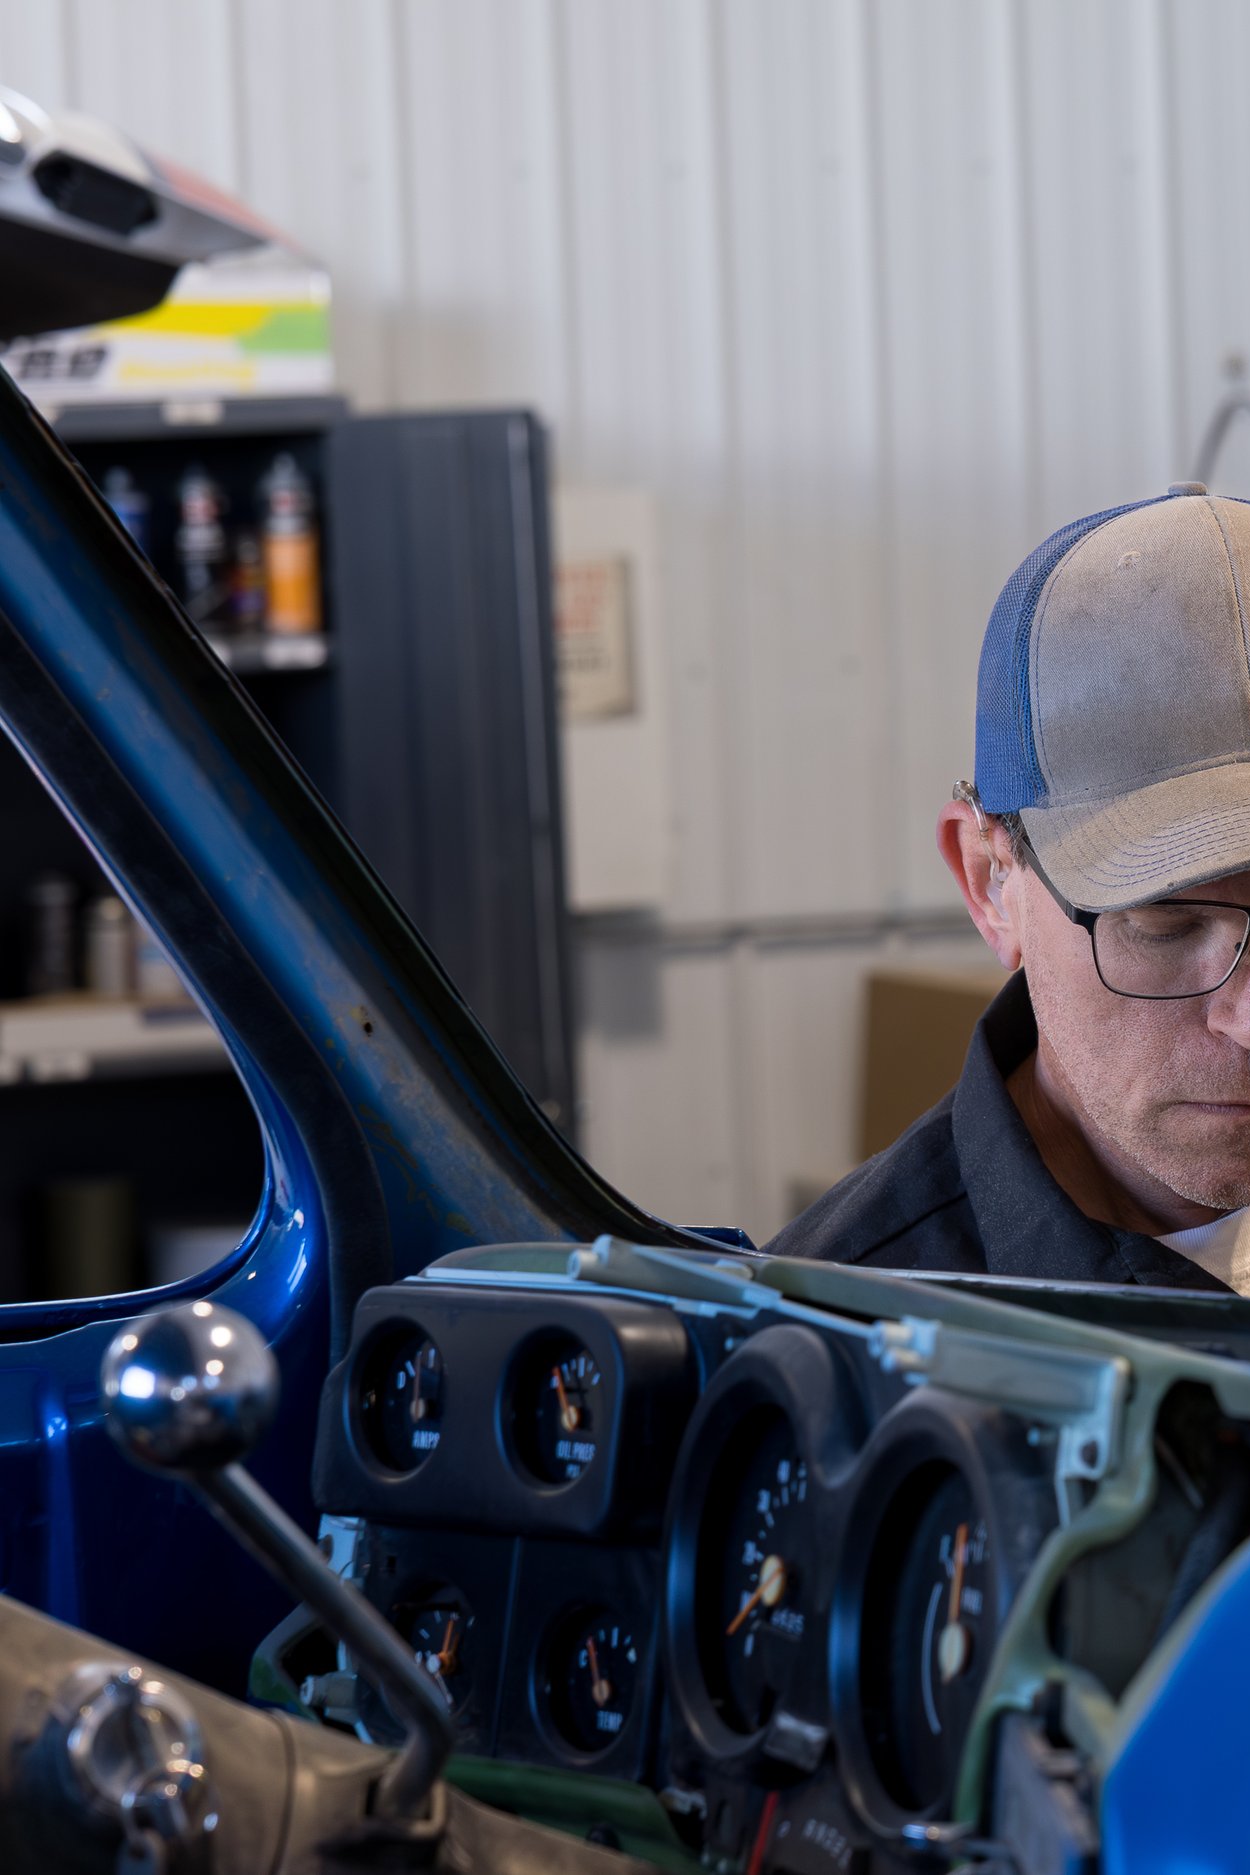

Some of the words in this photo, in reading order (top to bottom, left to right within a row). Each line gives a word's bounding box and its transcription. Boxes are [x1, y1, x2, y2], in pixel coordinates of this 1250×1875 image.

[412, 1430, 440, 1450] AMPS
[556, 1439, 572, 1460] OIL
[595, 1709, 624, 1733] TEMP
